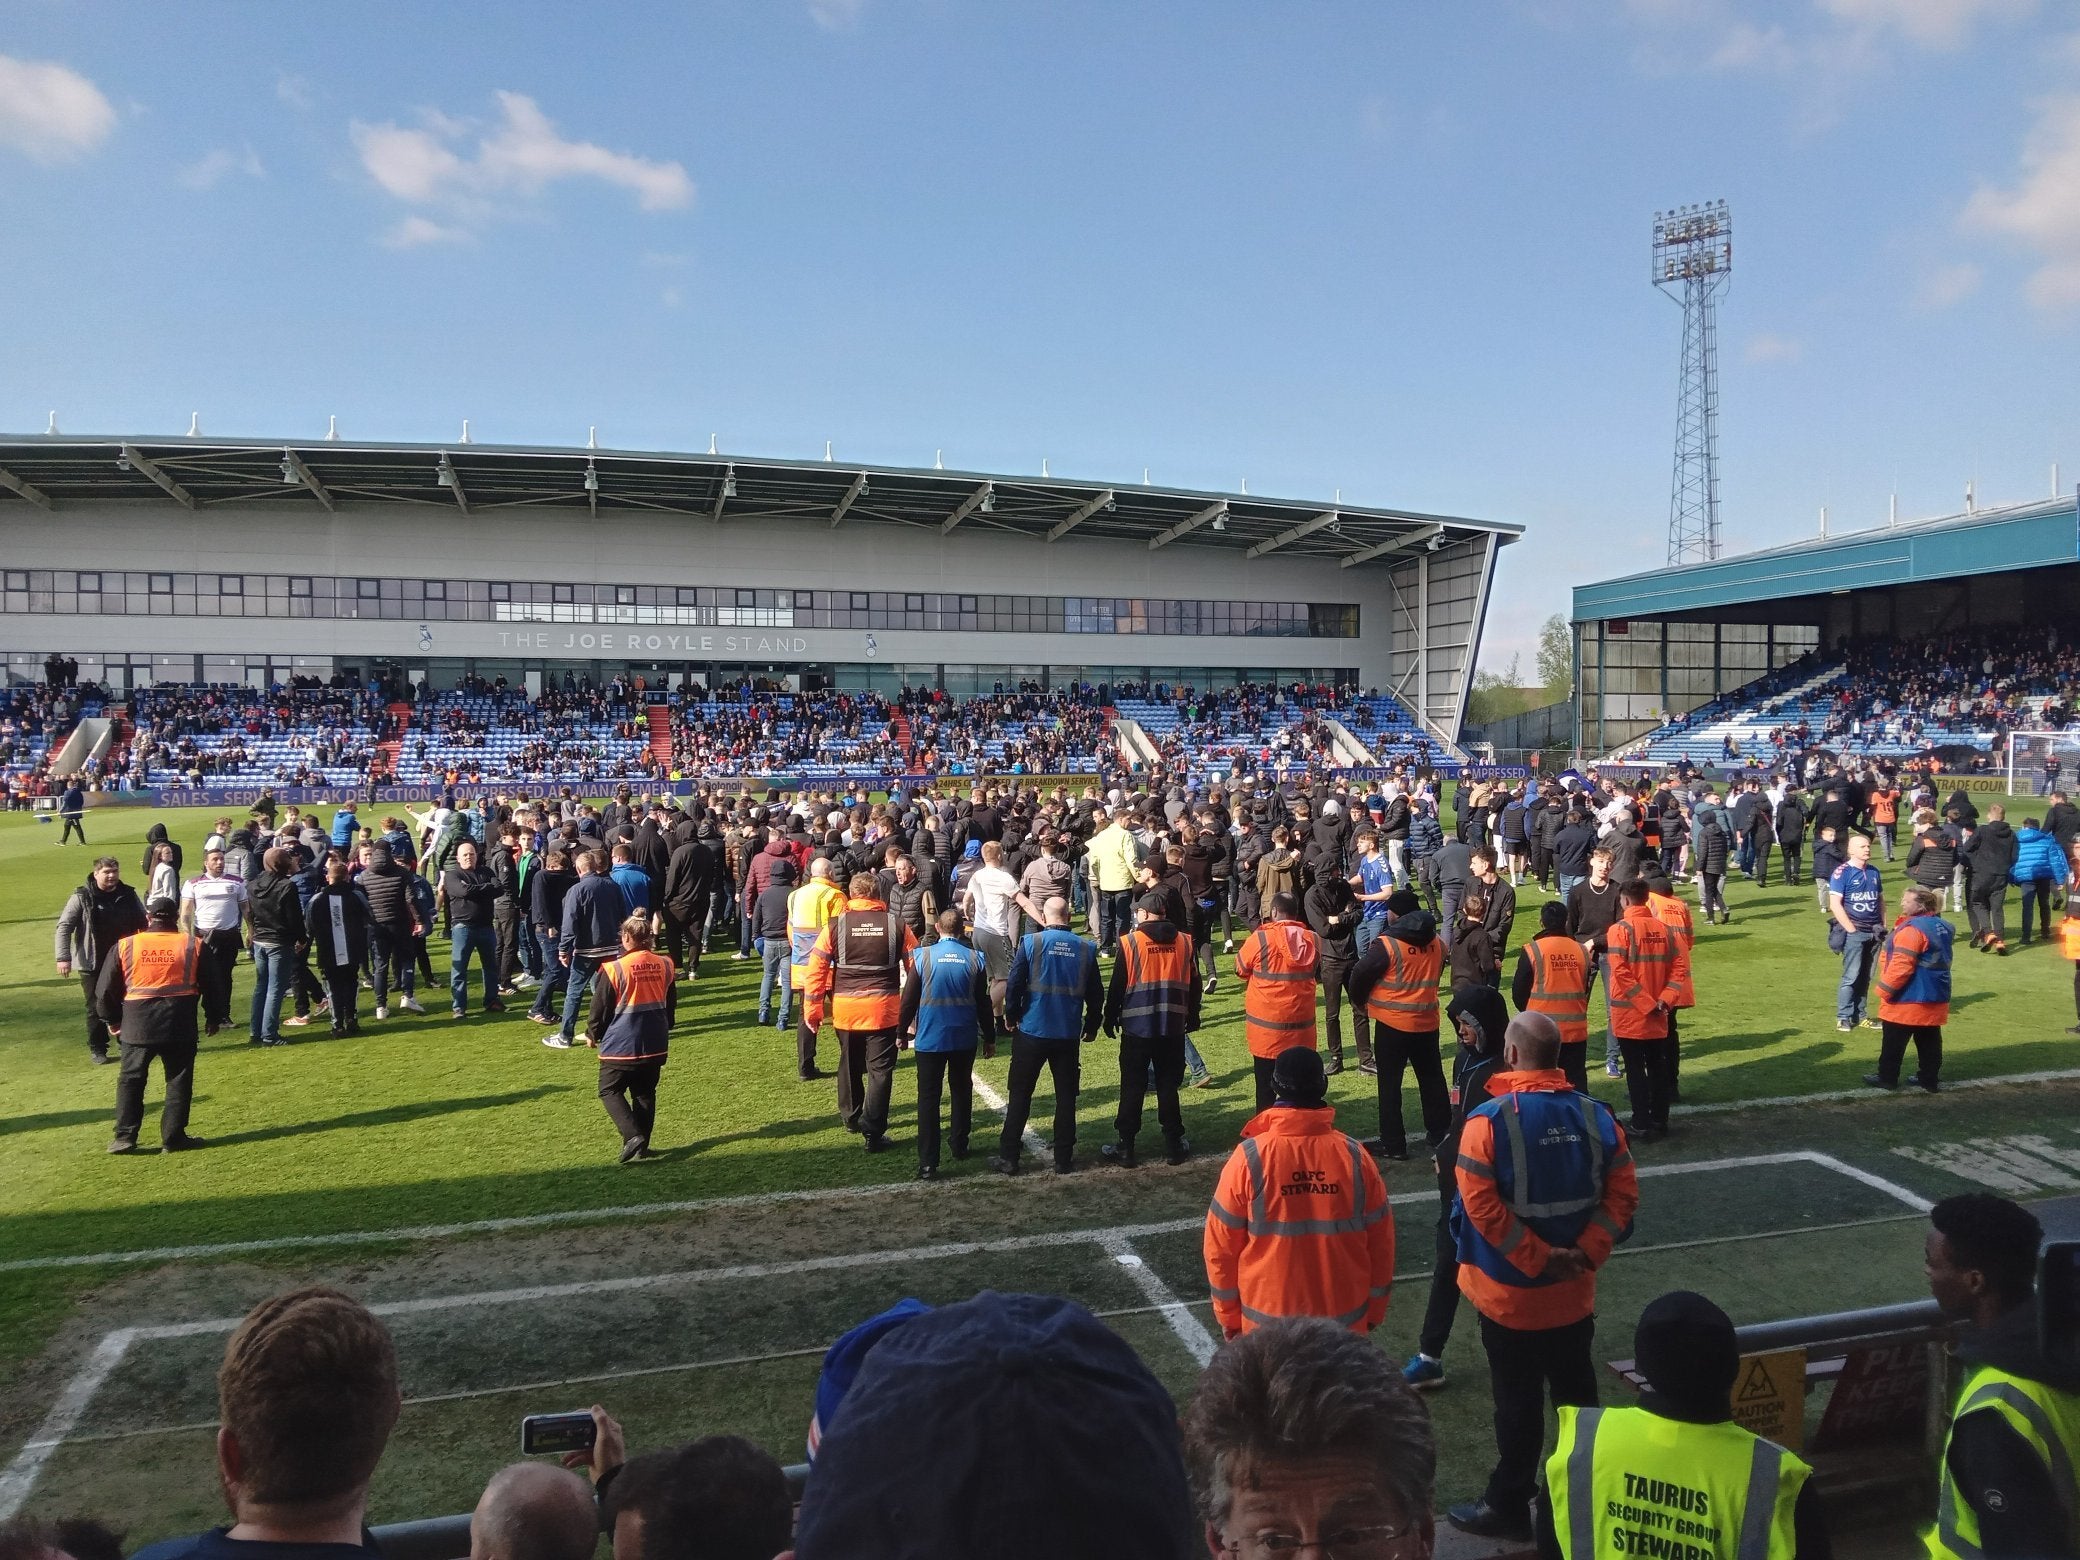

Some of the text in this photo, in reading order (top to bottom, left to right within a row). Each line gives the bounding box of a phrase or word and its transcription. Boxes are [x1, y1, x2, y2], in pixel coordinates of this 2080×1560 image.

[498, 632, 807, 652] THE JOE ROYLE STAND
[1457, 767, 1525, 780] CMPRESSED
[803, 780, 879, 792] COMPRESOR
[1025, 777, 1070, 787] BREAKDOWN
[1071, 775, 1099, 786] SERVICE
[1937, 779, 1970, 791] TRADE
[161, 792, 210, 806] SALES
[302, 788, 342, 804] LEAK
[345, 787, 431, 802] DEECTION
[453, 785, 544, 800] OMPRESSED
[575, 782, 679, 798] MANAEMENT
[1551, 960, 1578, 968] TAURUS
[1292, 1170, 1326, 1182] OAFC
[1280, 1182, 1339, 1196] STEWARD
[1624, 1472, 1708, 1517] TAURUS
[1607, 1501, 1722, 1545] SECURITY GROUP
